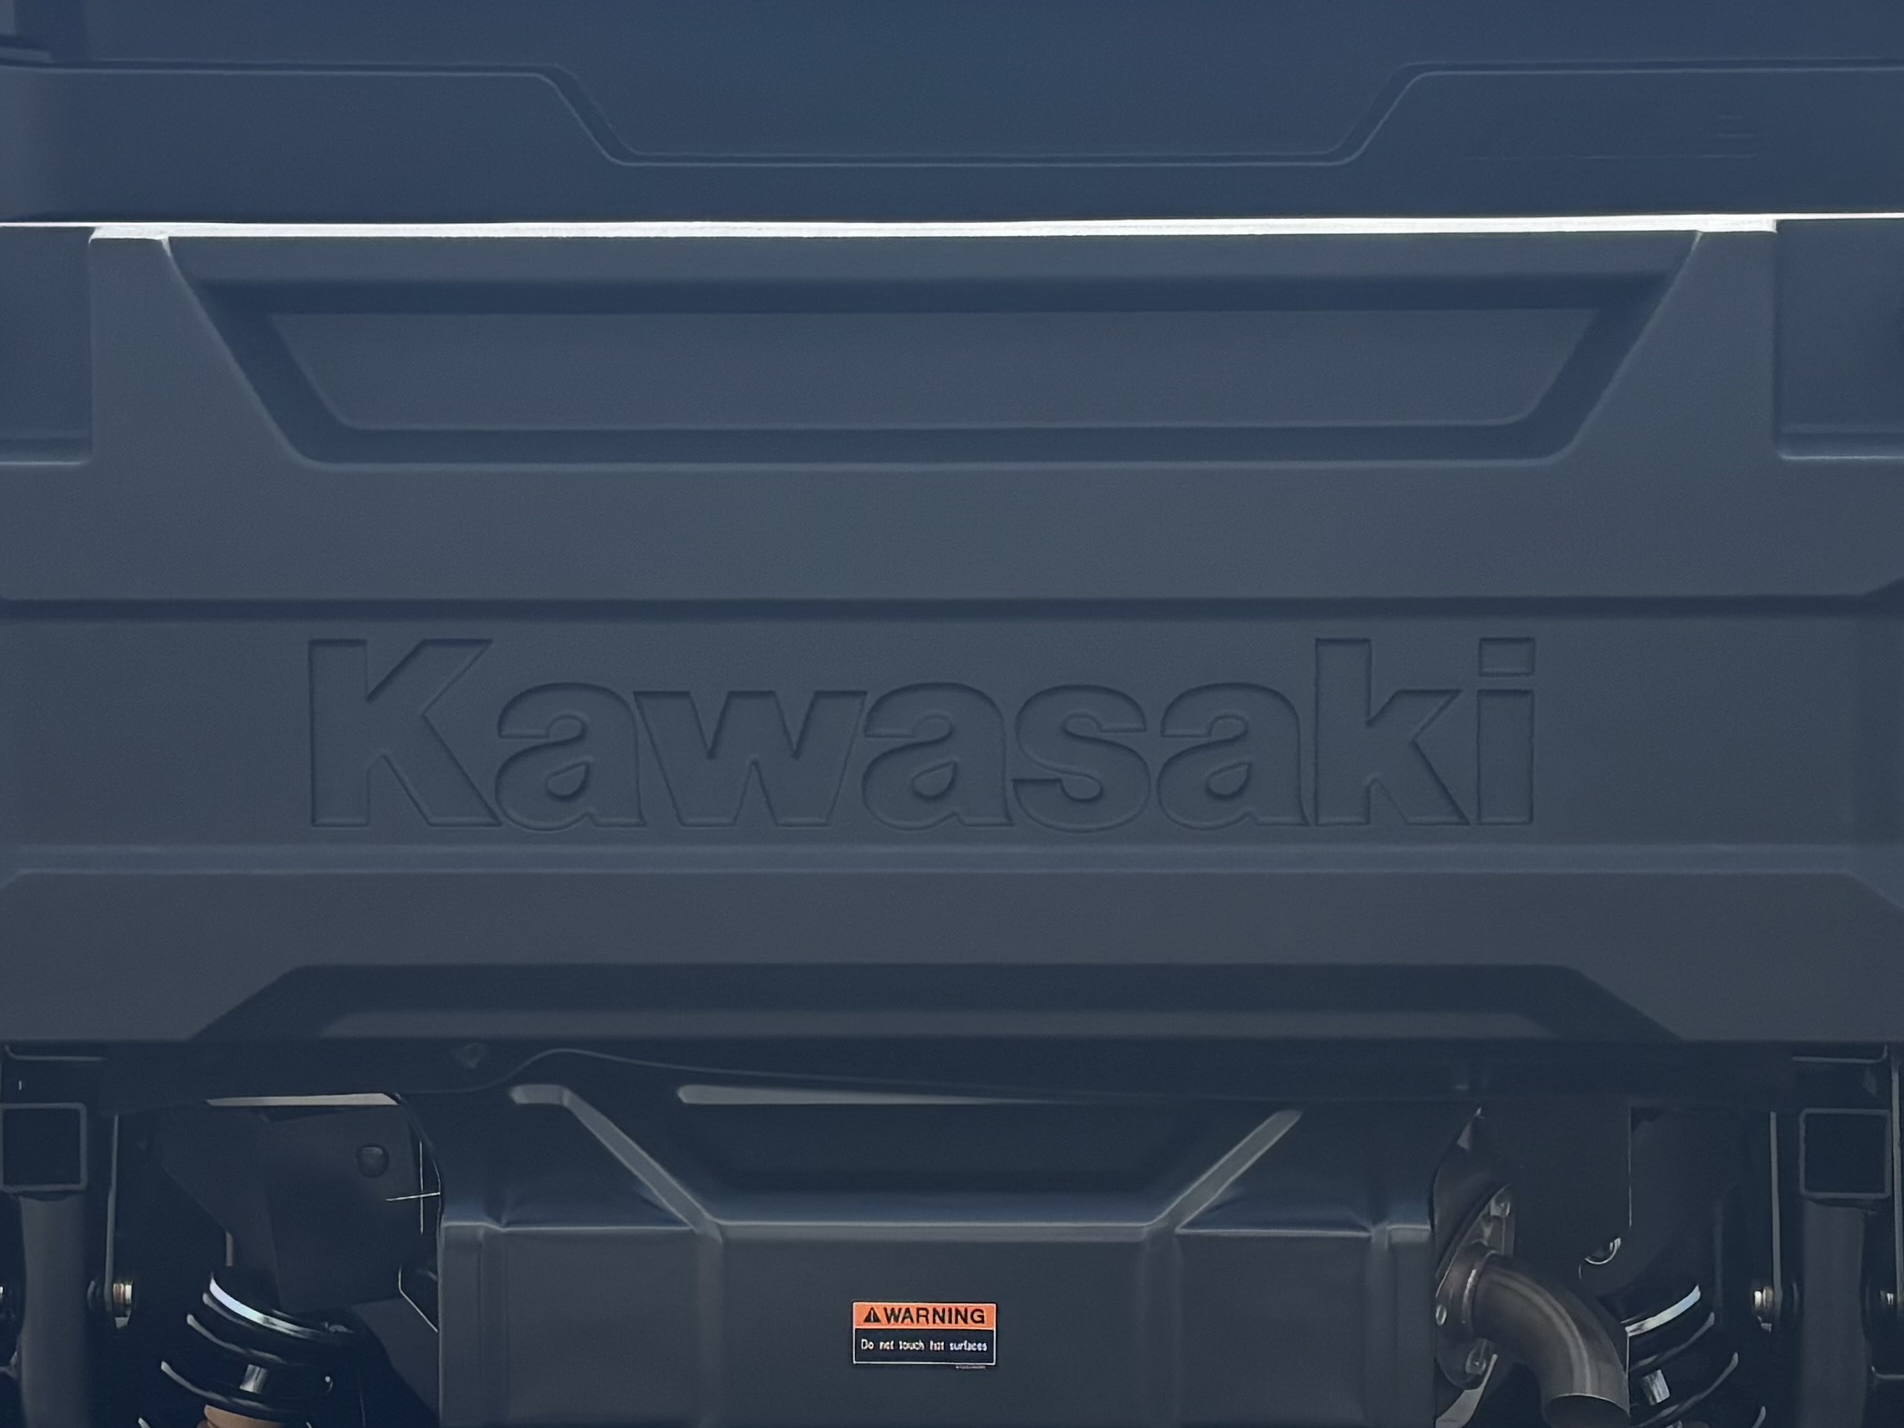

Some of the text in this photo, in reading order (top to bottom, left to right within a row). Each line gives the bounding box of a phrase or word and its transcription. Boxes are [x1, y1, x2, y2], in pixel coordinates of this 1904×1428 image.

[307, 637, 1536, 833] Kawasaki
[883, 1307, 986, 1325] WARNING
[860, 1338, 874, 1351] Do
[898, 1339, 925, 1352] touch
[949, 1339, 988, 1352] surfaces
